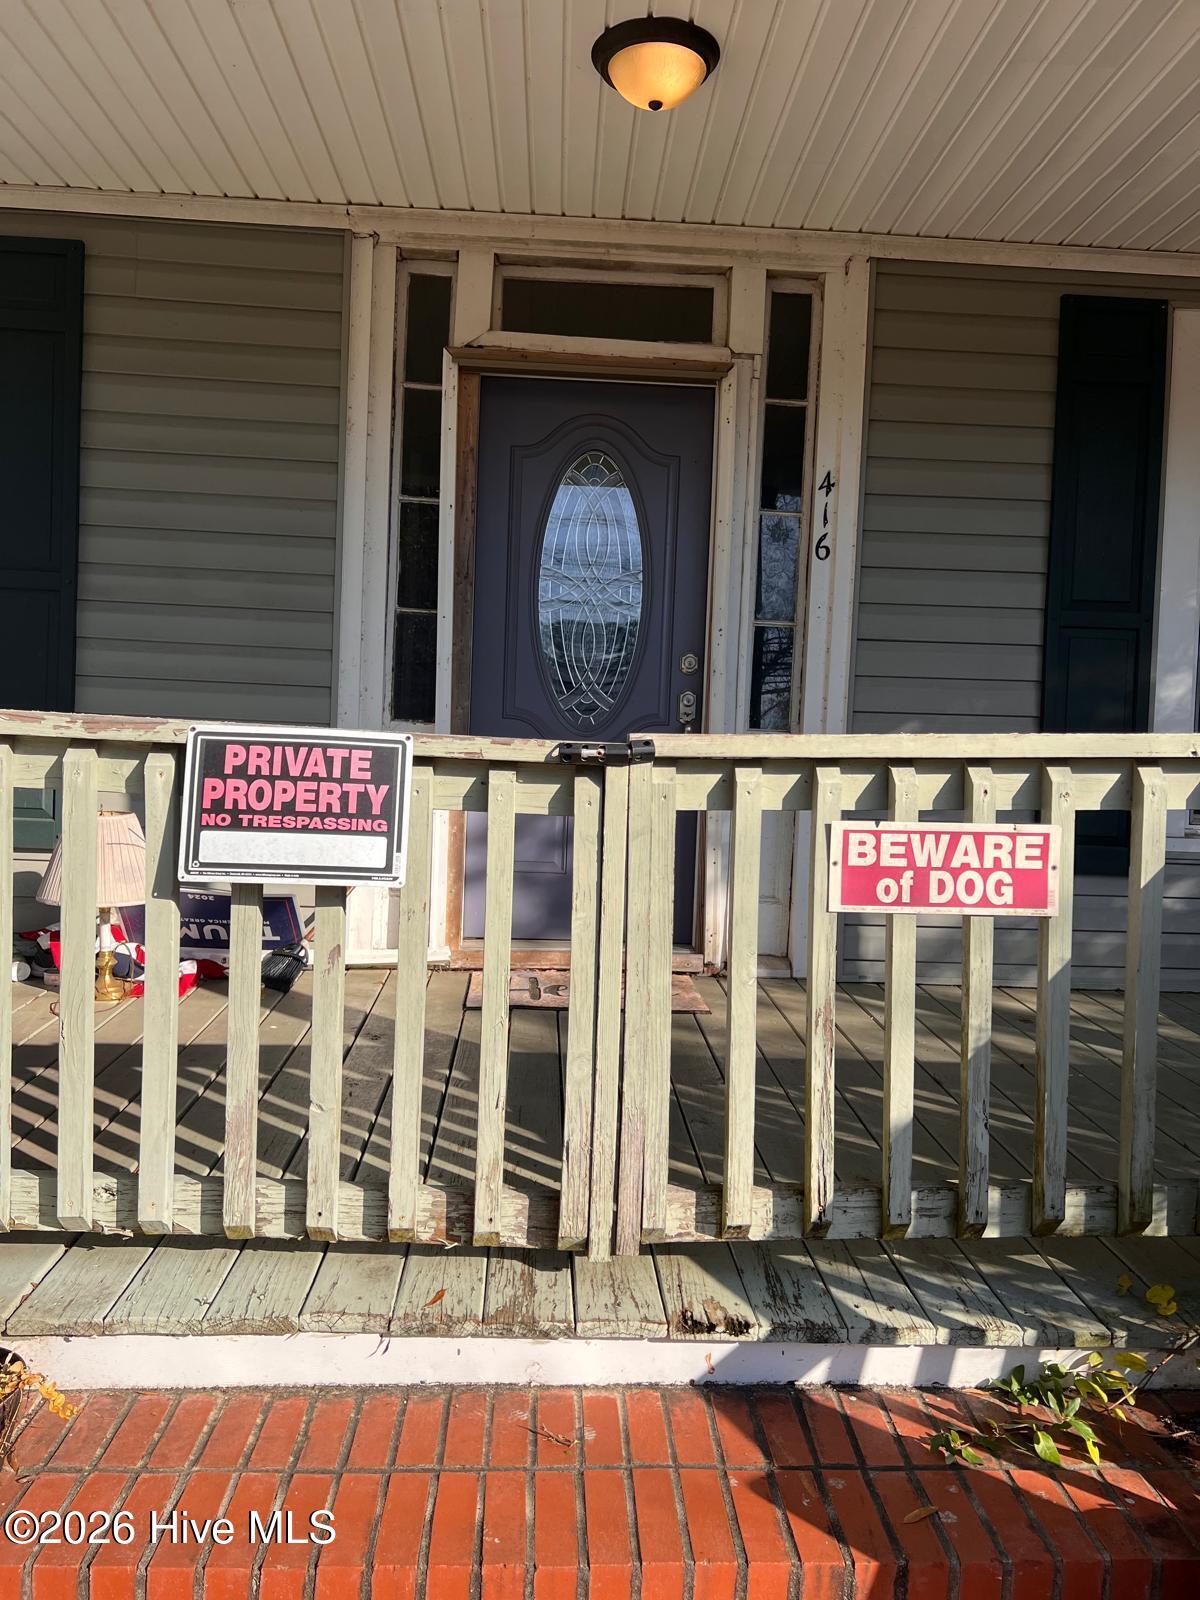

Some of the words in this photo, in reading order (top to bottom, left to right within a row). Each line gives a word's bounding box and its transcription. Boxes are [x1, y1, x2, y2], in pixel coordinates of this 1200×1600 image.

[815, 471, 835, 561] 416
[224, 744, 373, 780] PRIVATE
[202, 777, 389, 815] PROPERTY
[201, 813, 232, 827] NO
[239, 814, 388, 832] TRESPASSING
[847, 832, 1044, 870] BEWARE
[187, 893, 214, 901] 2024
[876, 870, 914, 904] of
[928, 870, 1014, 905] DOG
[180, 924, 280, 940] TUM
